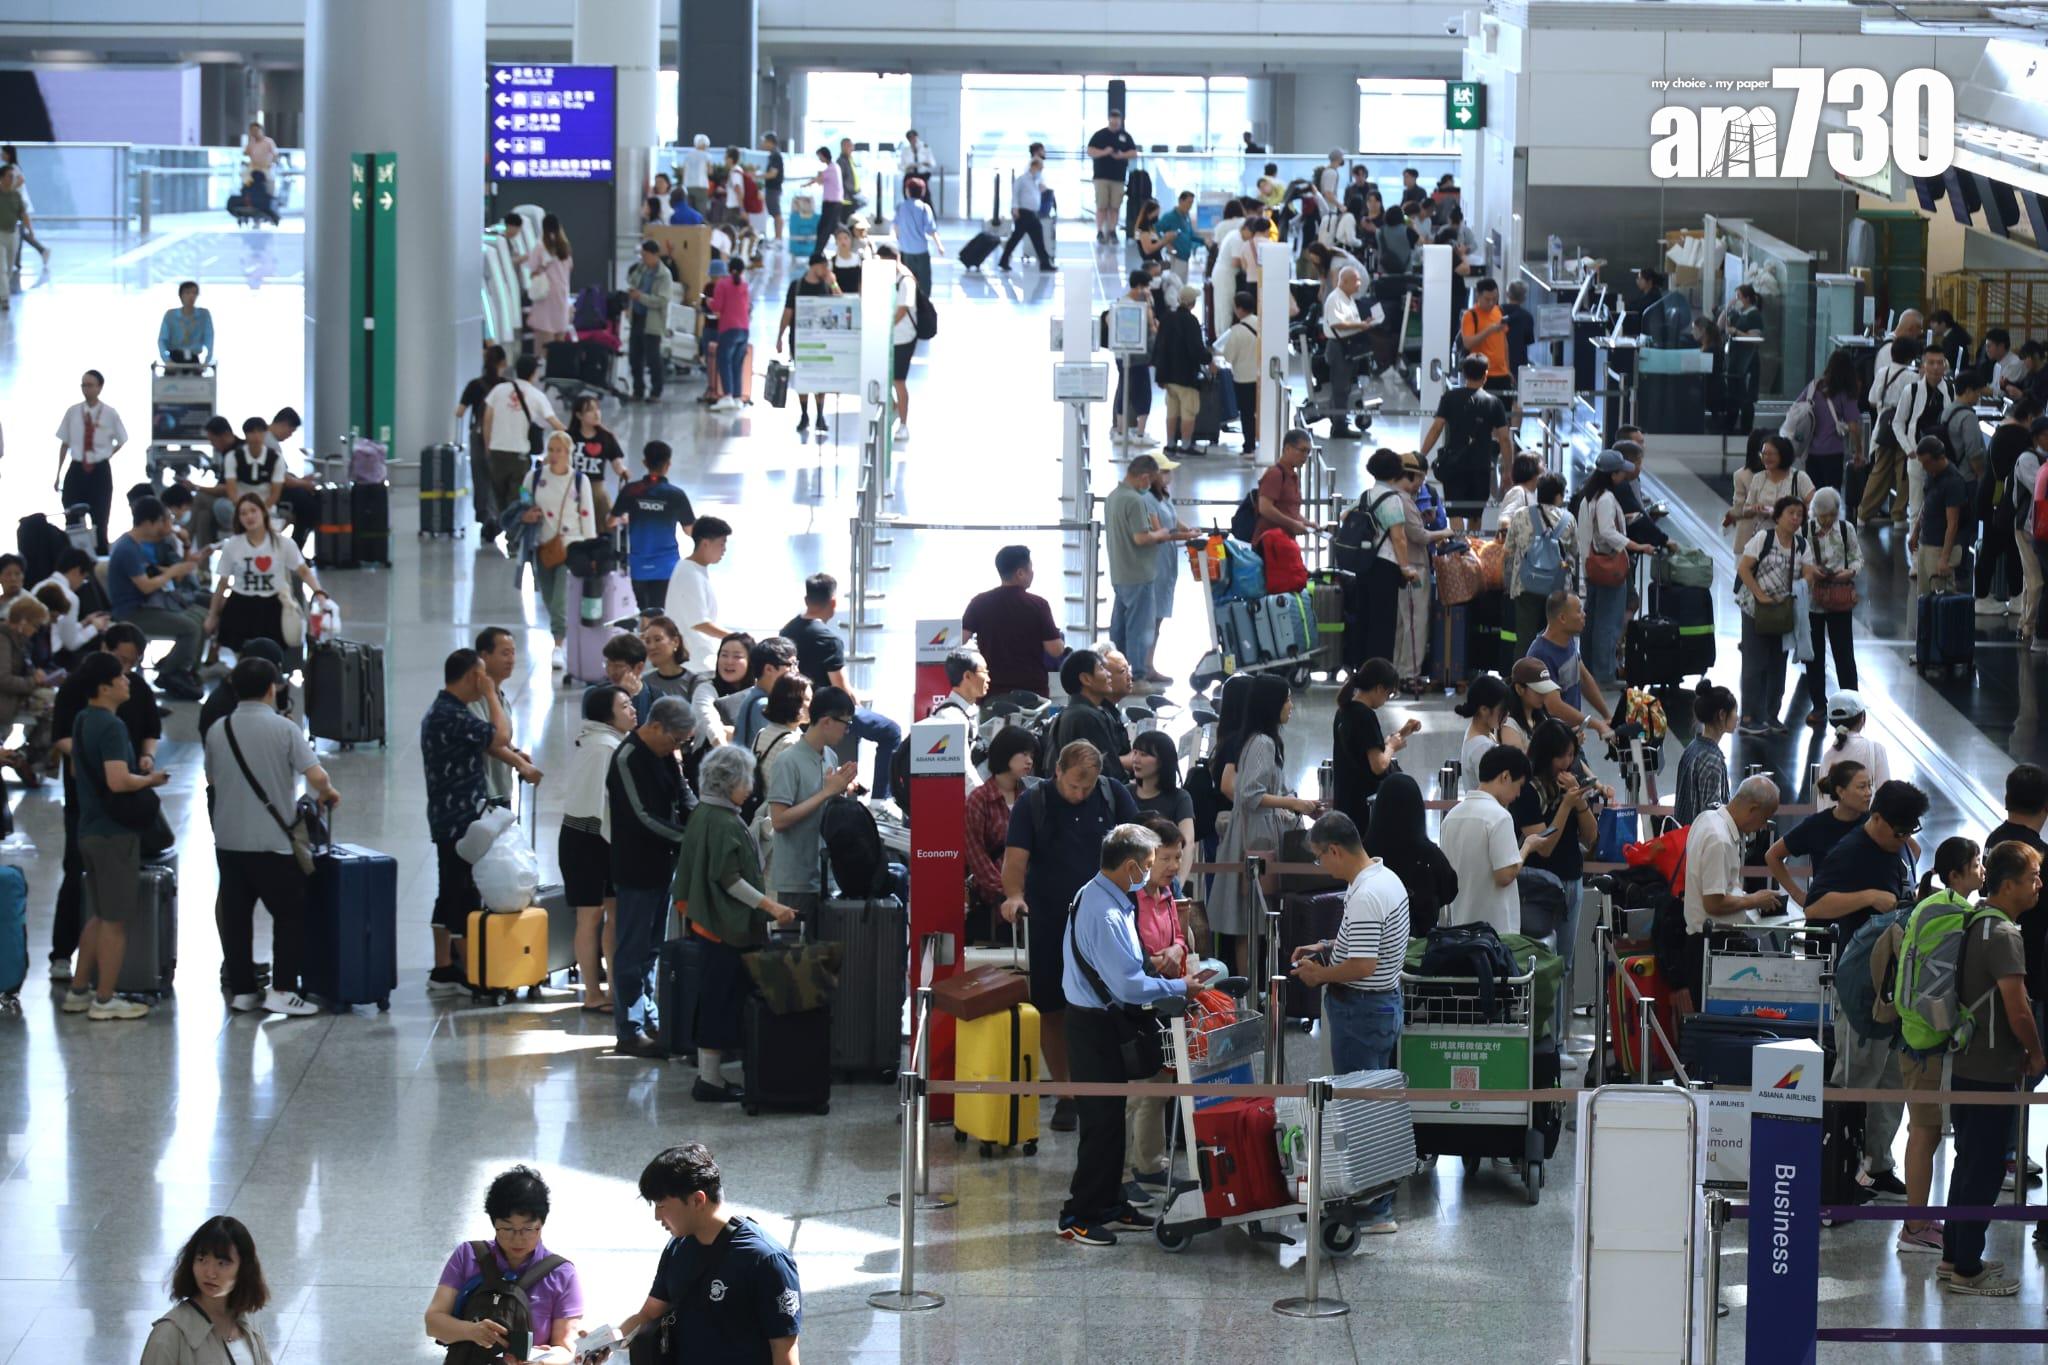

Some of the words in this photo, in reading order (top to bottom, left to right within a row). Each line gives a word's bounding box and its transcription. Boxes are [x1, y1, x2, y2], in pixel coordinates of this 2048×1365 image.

[575, 442, 585, 457] I
[573, 458, 602, 473] HK
[244, 557, 253, 575] I
[244, 575, 274, 591] HK
[917, 849, 959, 859] Economy
[1715, 1100, 1745, 1108] AIRLINES
[1758, 1090, 1784, 1099] ASIANA
[1785, 1093, 1817, 1103] AIRLINES
[1772, 1164, 1796, 1275] Business
